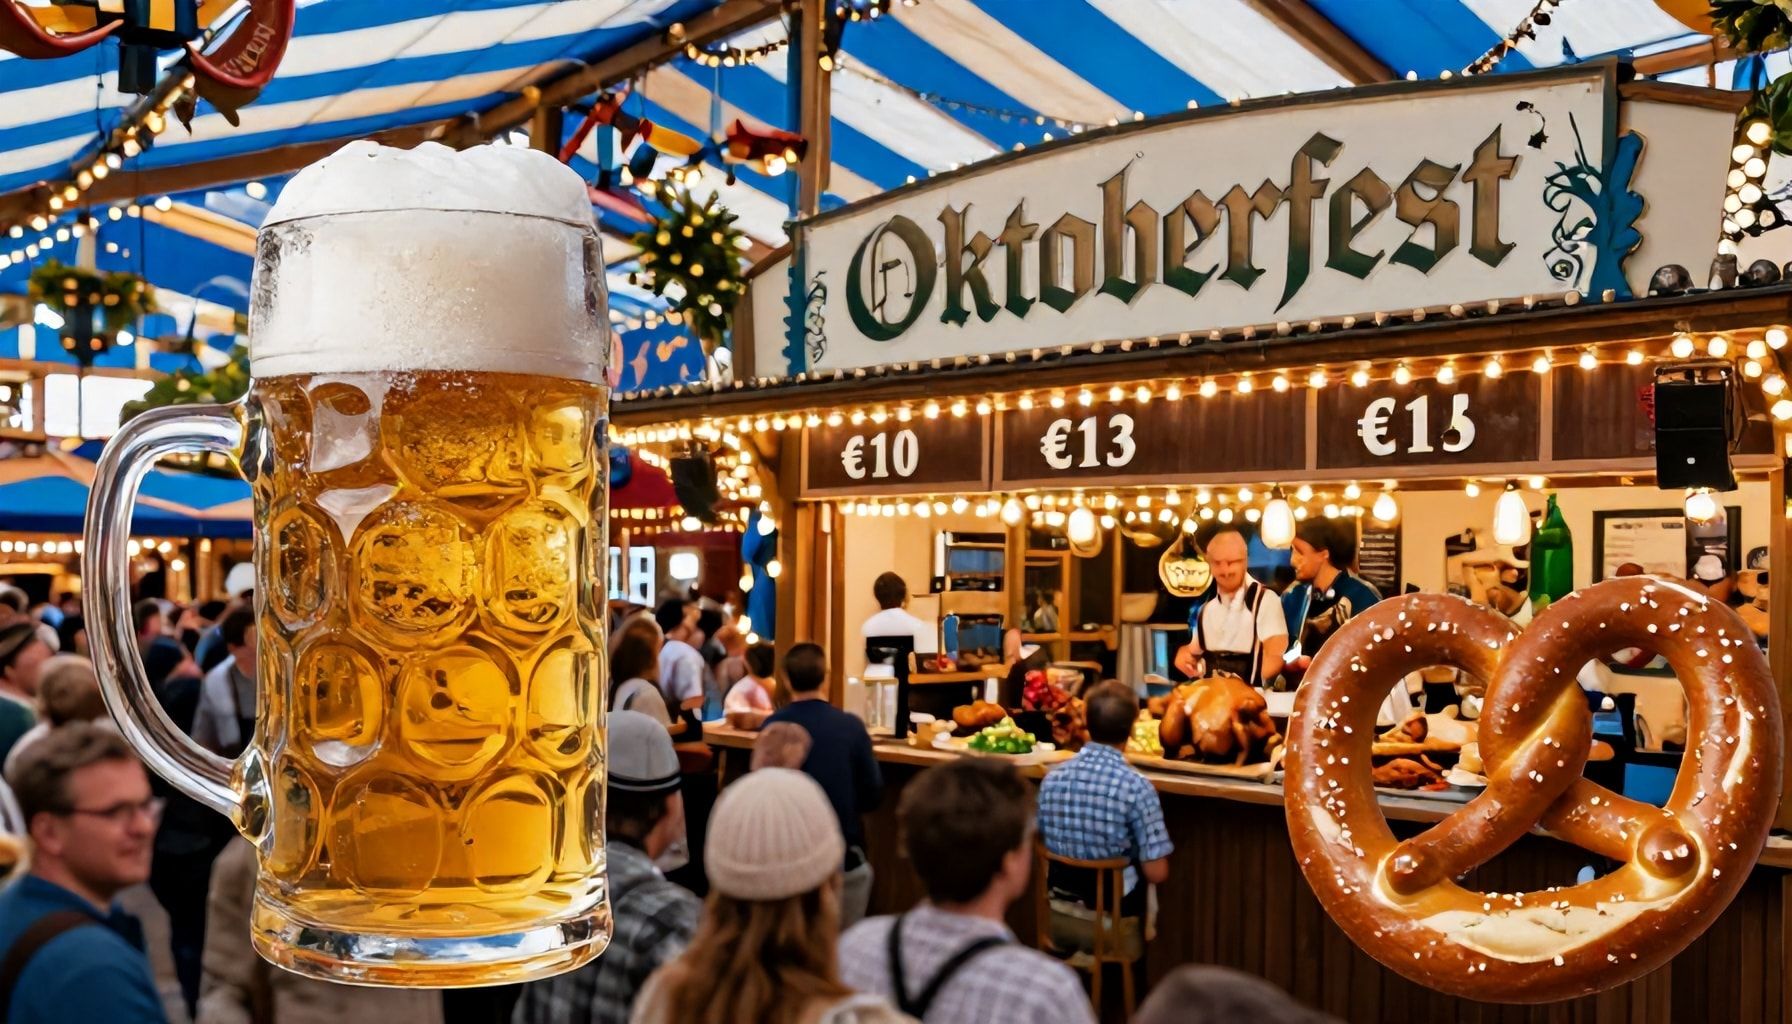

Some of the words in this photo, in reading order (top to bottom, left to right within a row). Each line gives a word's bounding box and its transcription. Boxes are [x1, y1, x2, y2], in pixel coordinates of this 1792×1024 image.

[845, 124, 1523, 341] Oktoberfest
[841, 429, 919, 479] €10
[1040, 413, 1136, 469] €13
